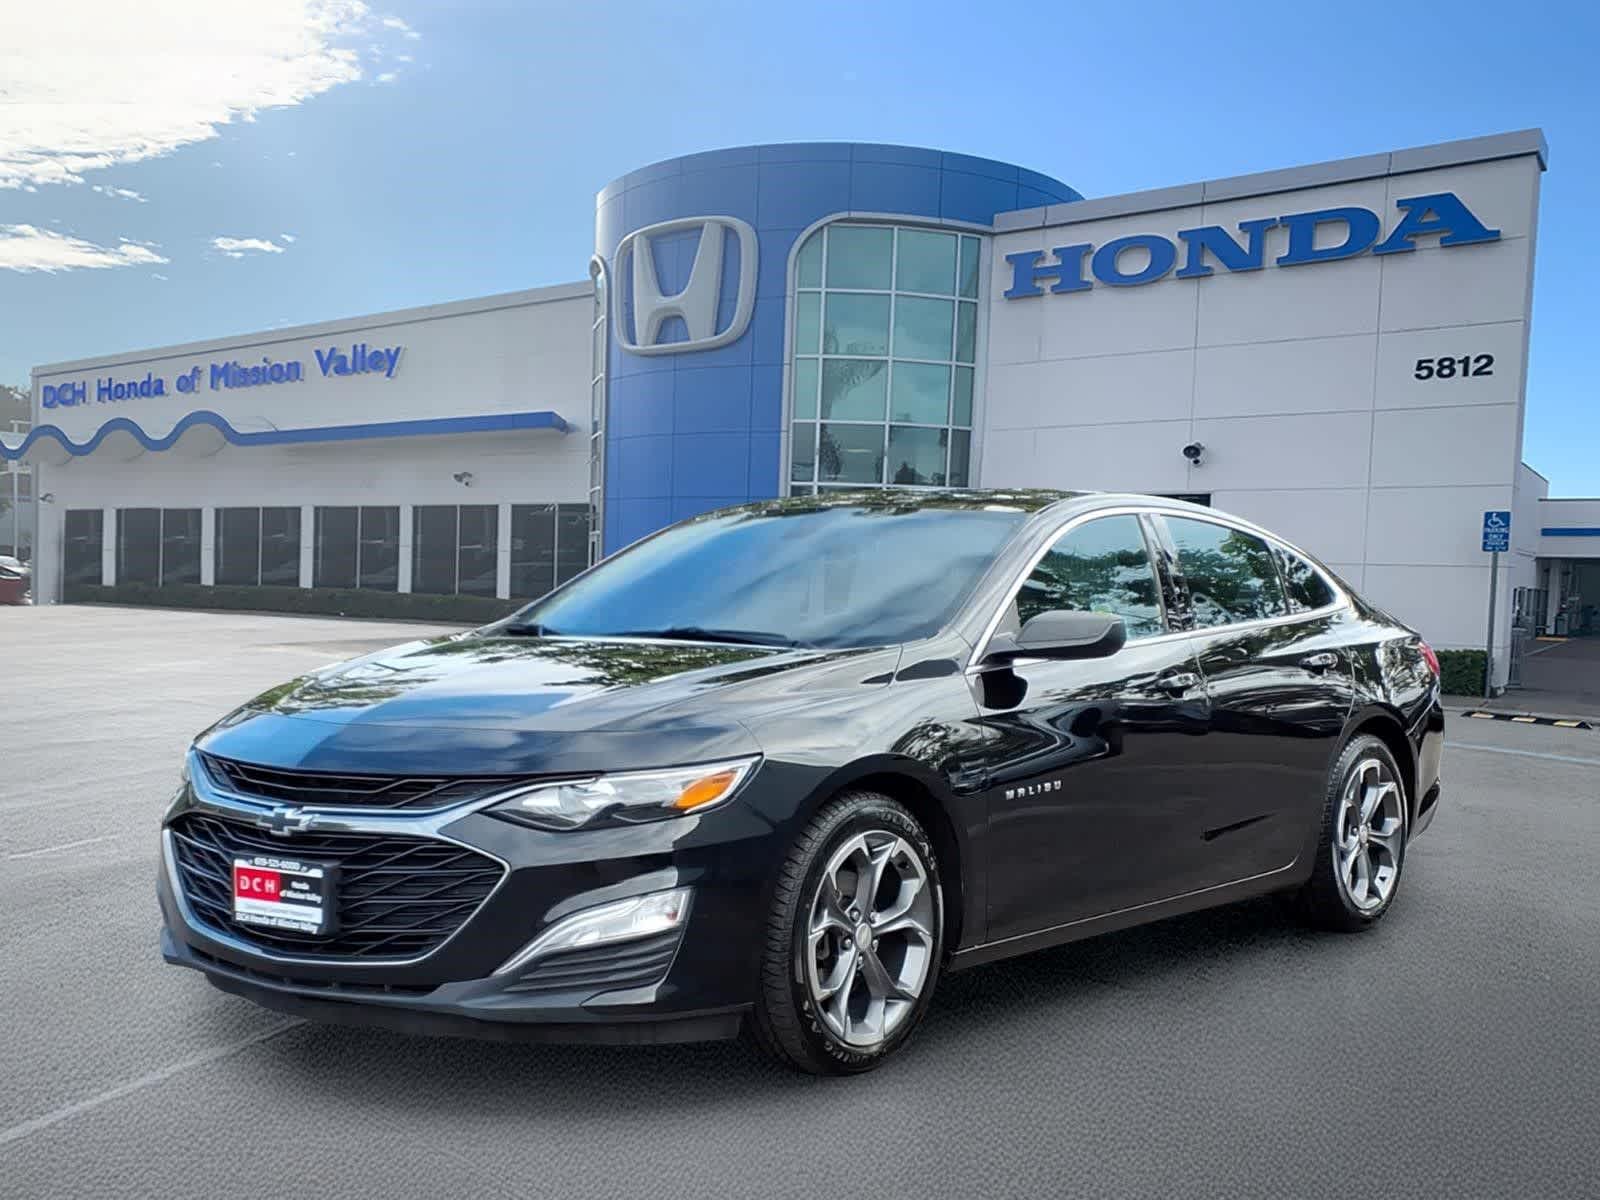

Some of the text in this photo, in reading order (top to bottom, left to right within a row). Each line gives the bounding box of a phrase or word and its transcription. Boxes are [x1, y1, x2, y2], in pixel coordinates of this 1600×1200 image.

[1003, 192, 1501, 299] HONDA
[42, 343, 401, 409] DCH Honda of Mission Valley
[1414, 354, 1495, 380] 5812
[1005, 780, 1062, 800] MALIBU
[240, 876, 276, 894] DCH
